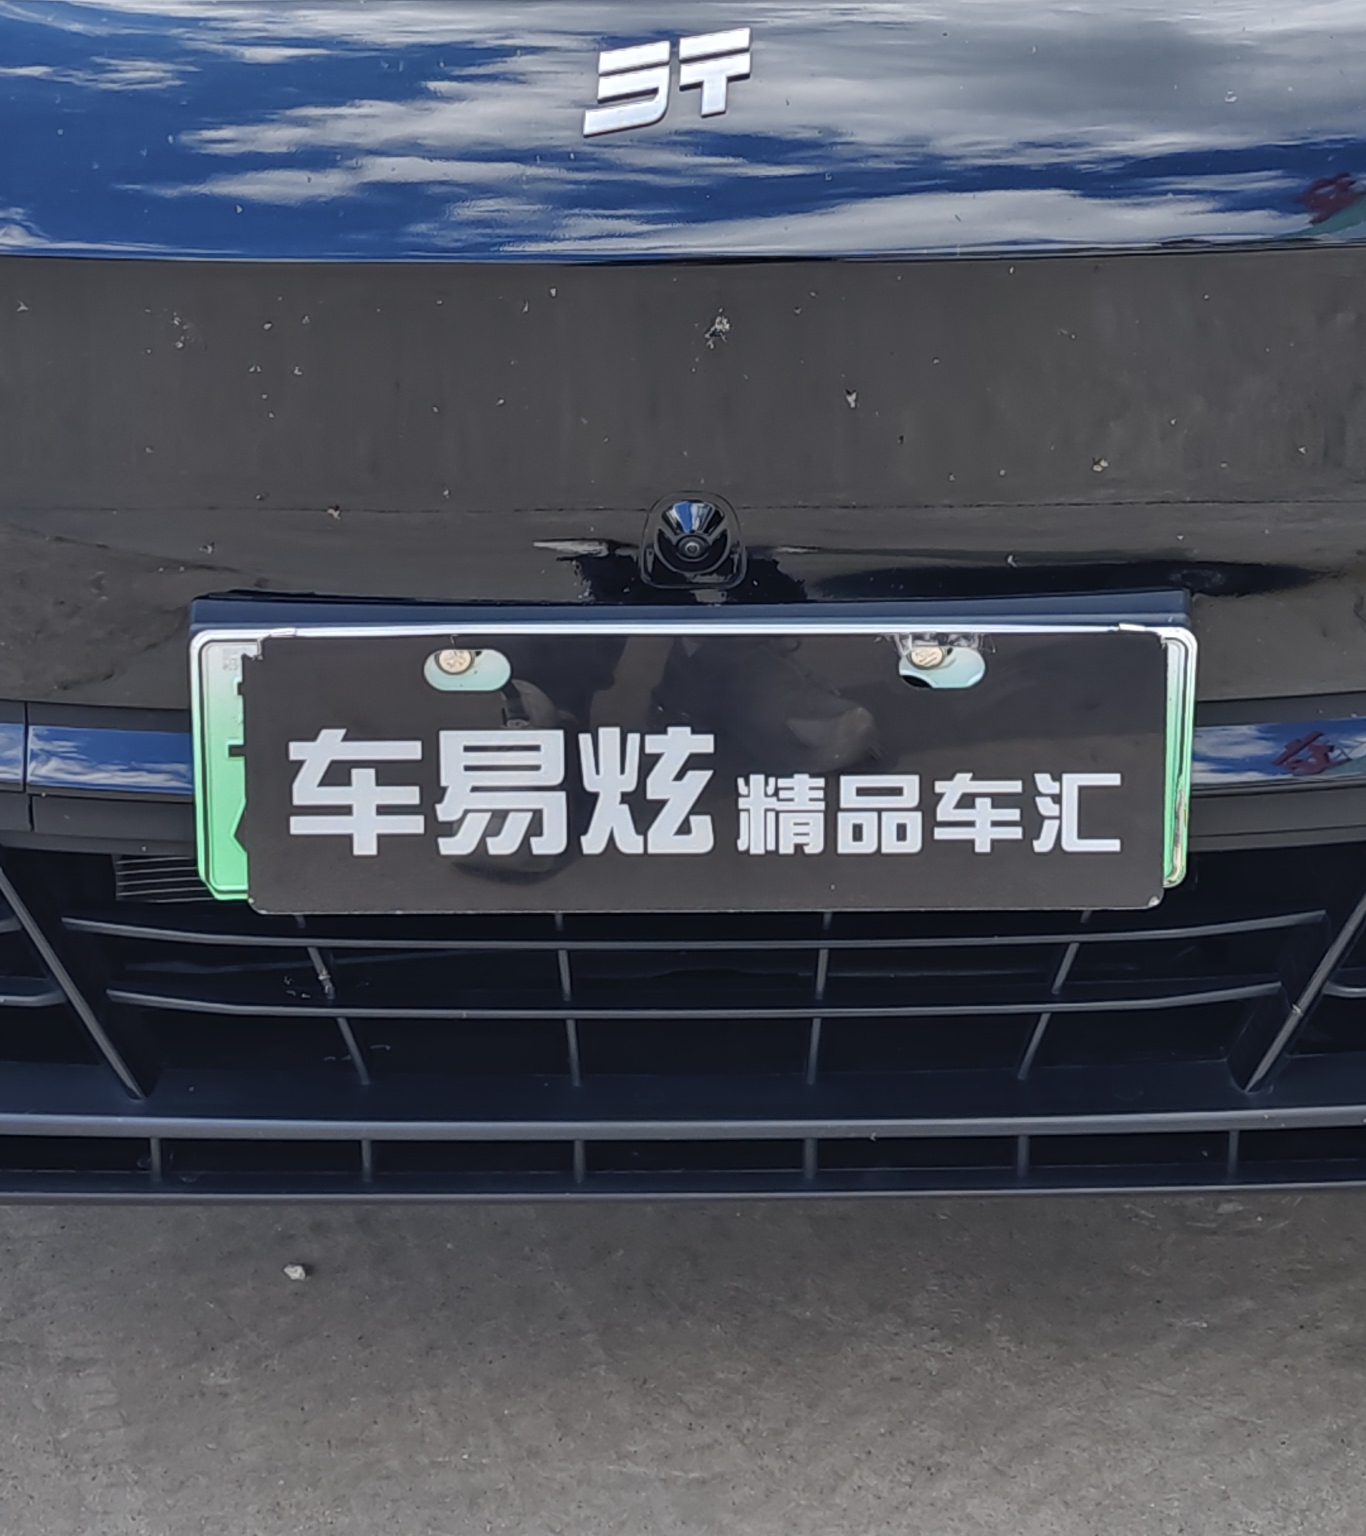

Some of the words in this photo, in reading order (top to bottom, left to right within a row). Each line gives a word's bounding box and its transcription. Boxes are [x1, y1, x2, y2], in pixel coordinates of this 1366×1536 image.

[288, 725, 716, 856] 车易炫
[736, 772, 1123, 855] 精品车汇
